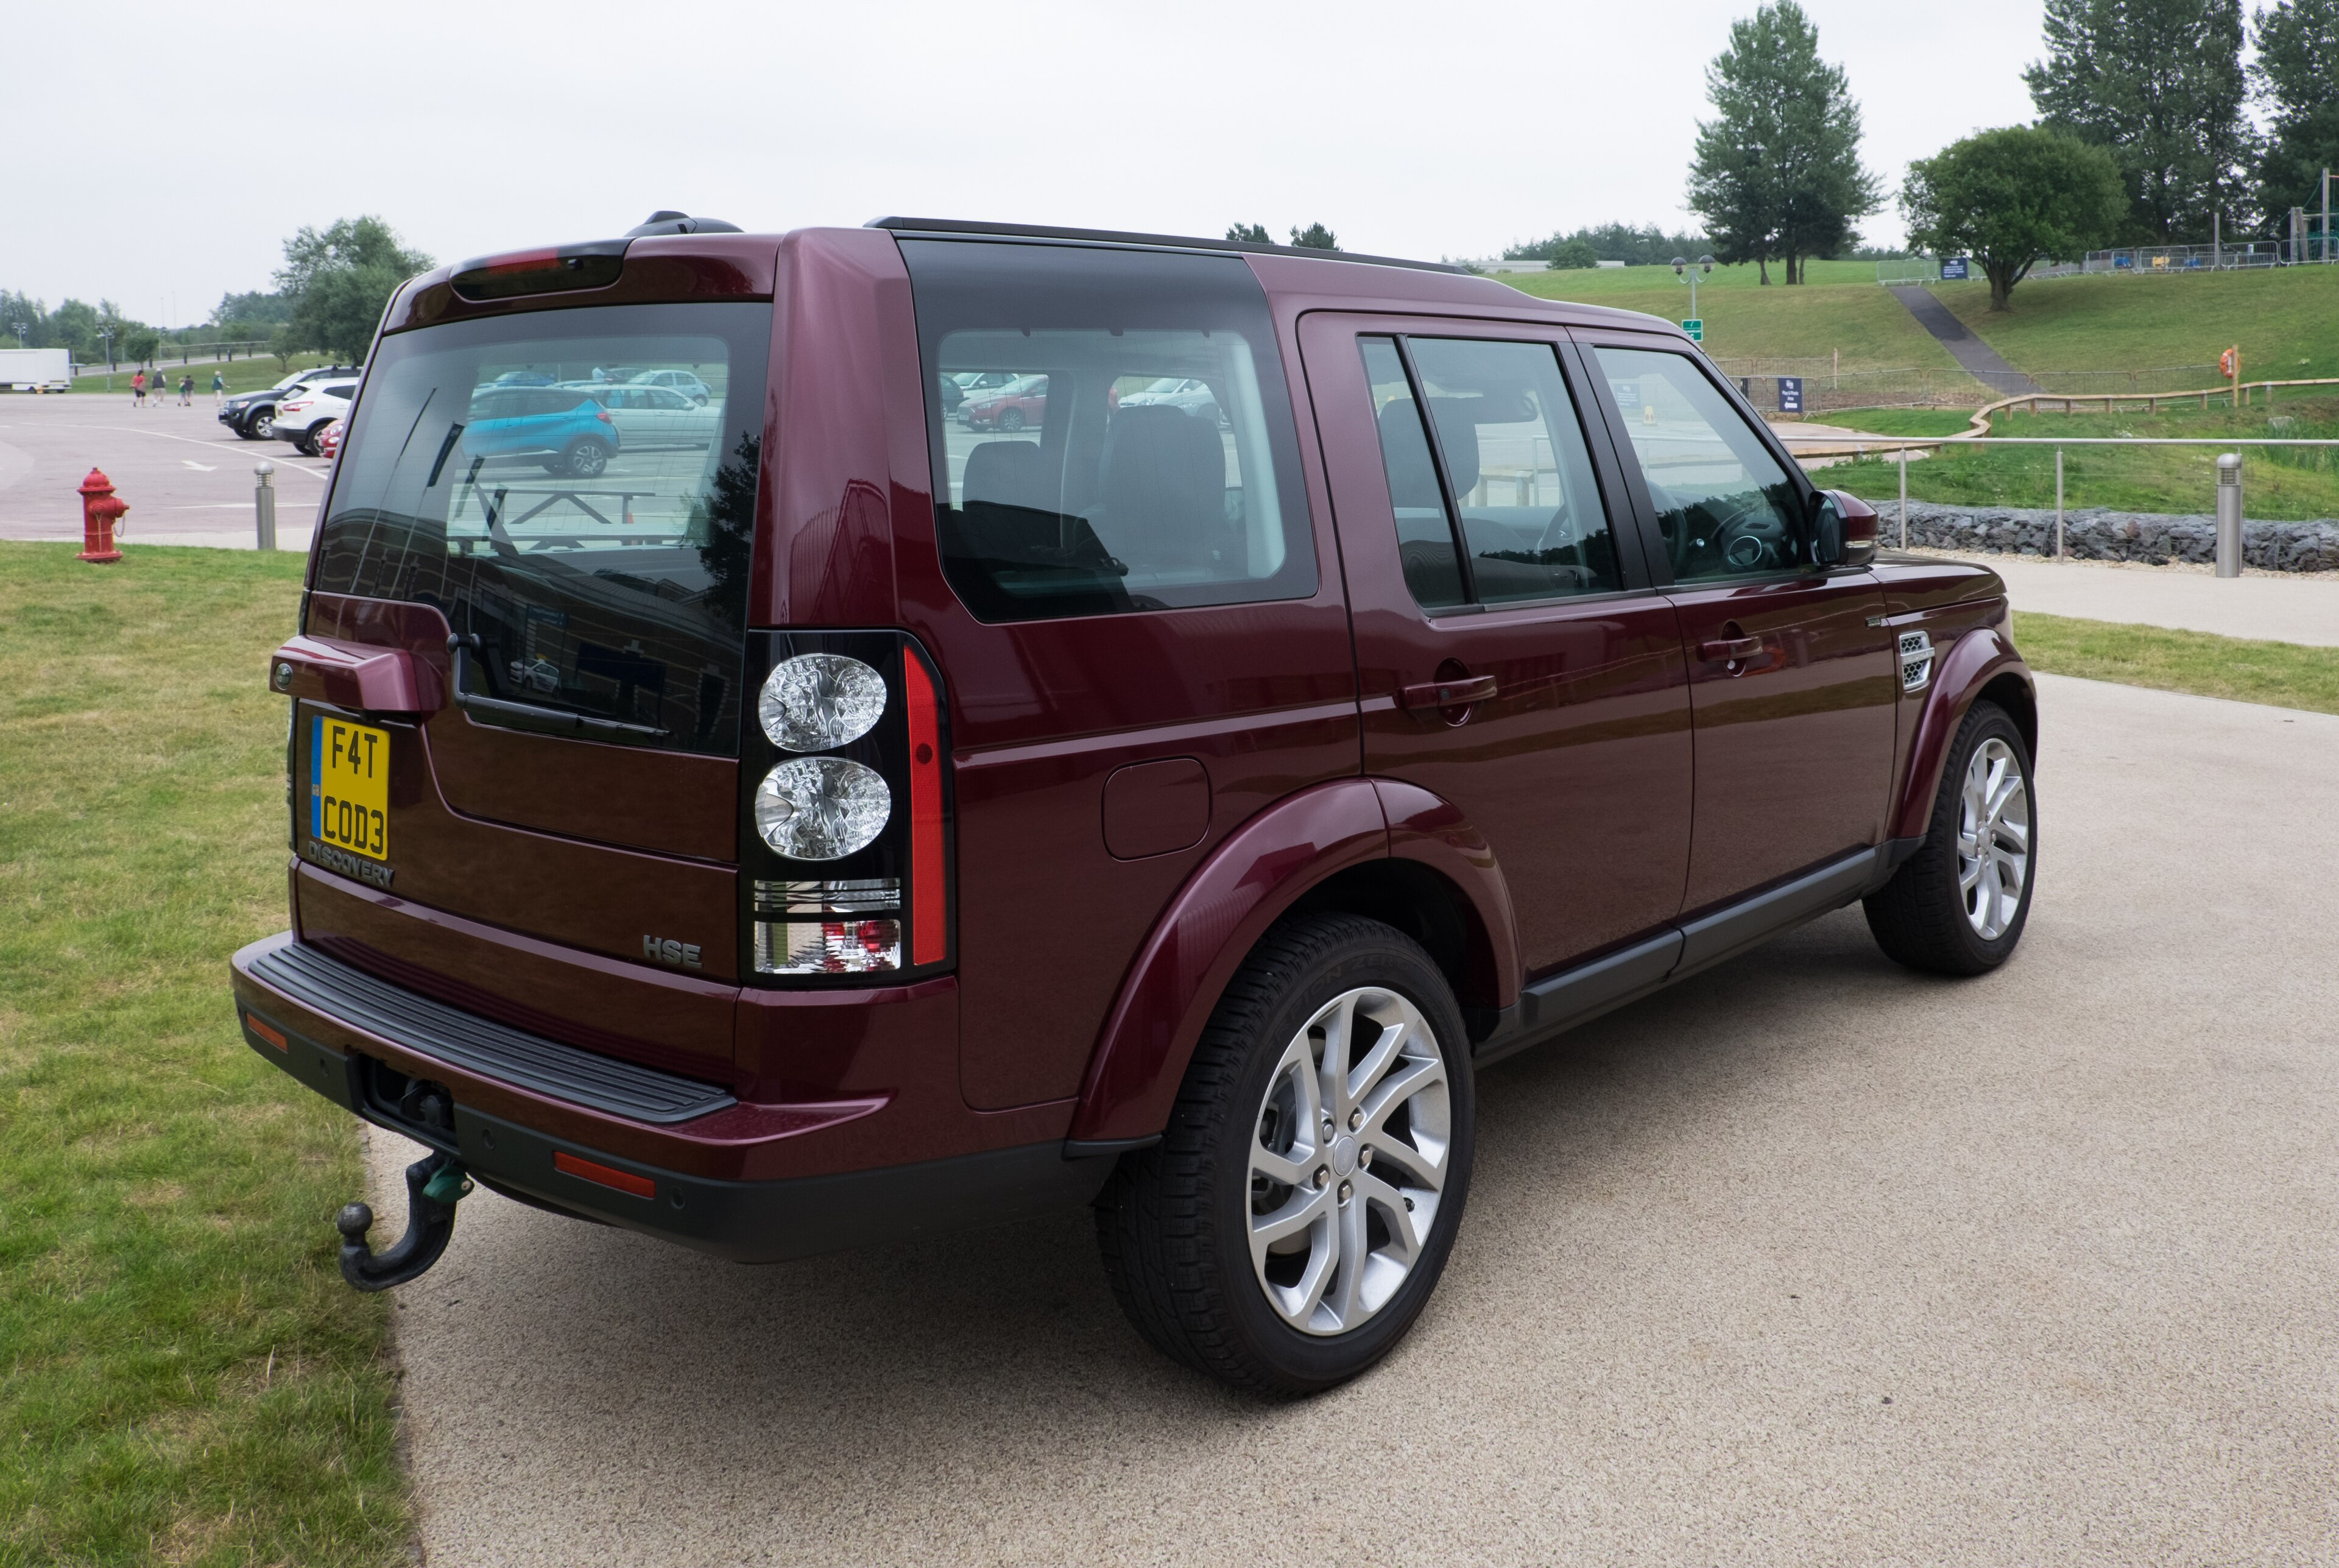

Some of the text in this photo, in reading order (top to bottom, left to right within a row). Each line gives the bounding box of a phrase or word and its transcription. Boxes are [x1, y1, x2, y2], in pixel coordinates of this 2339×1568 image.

[332, 725, 378, 779] F4T
[309, 841, 395, 888] DISCOVERY
[643, 934, 702, 969] HSE
